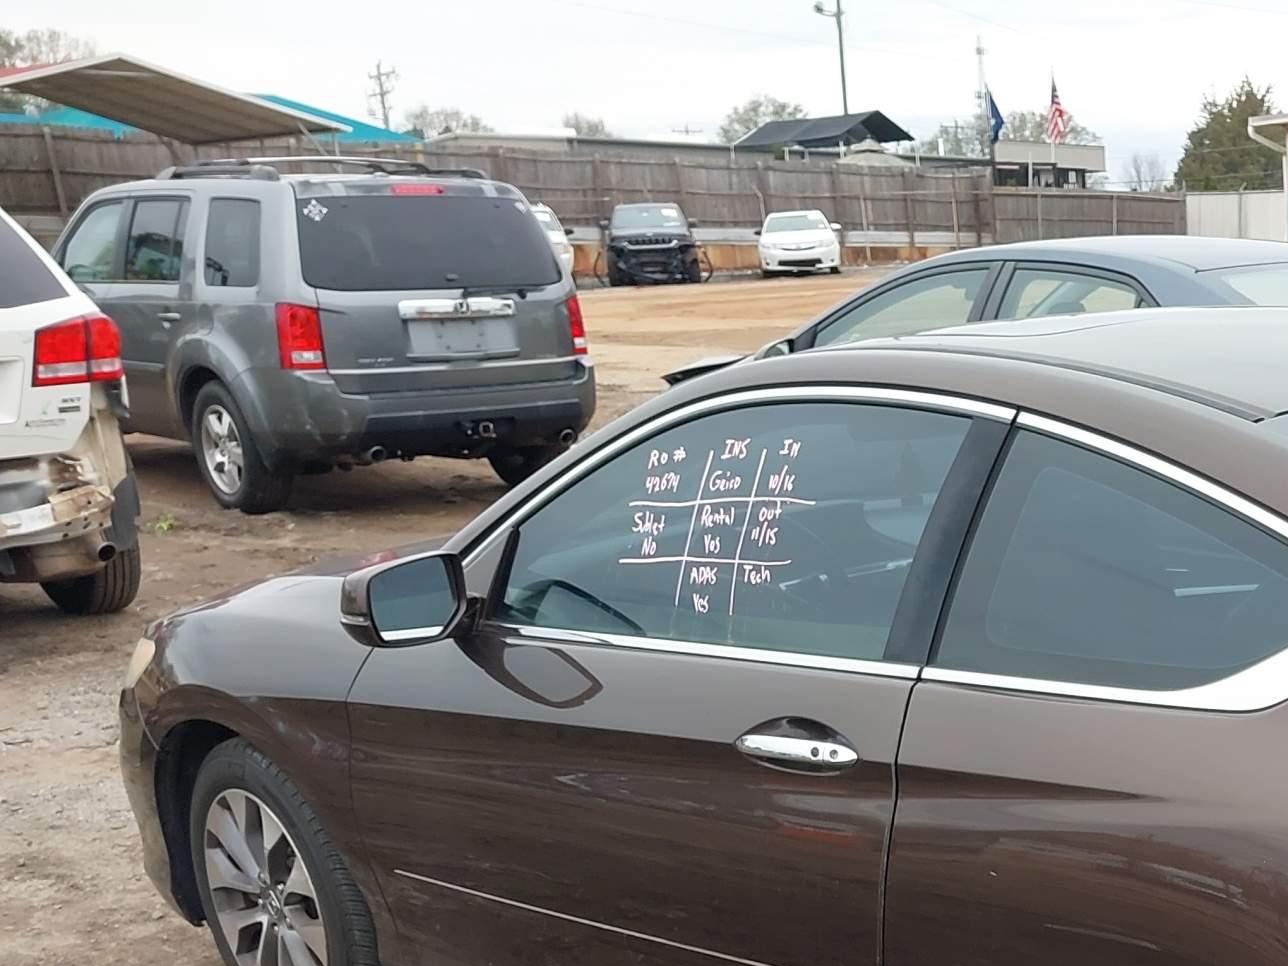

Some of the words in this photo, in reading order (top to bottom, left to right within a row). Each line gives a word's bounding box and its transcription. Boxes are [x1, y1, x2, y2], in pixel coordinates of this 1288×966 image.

[647, 449, 669, 470] RO
[673, 446, 687, 463] #
[720, 438, 752, 460] INS
[779, 438, 801, 458] IN
[709, 470, 742, 492] Geico
[768, 464, 796, 496] 10/16
[700, 504, 735, 528] Rental
[703, 533, 720, 555] Yes
[750, 521, 779, 548] 11/15
[689, 565, 718, 585] ADAS
[743, 564, 771, 585] Tech
[692, 592, 710, 614] Yes
